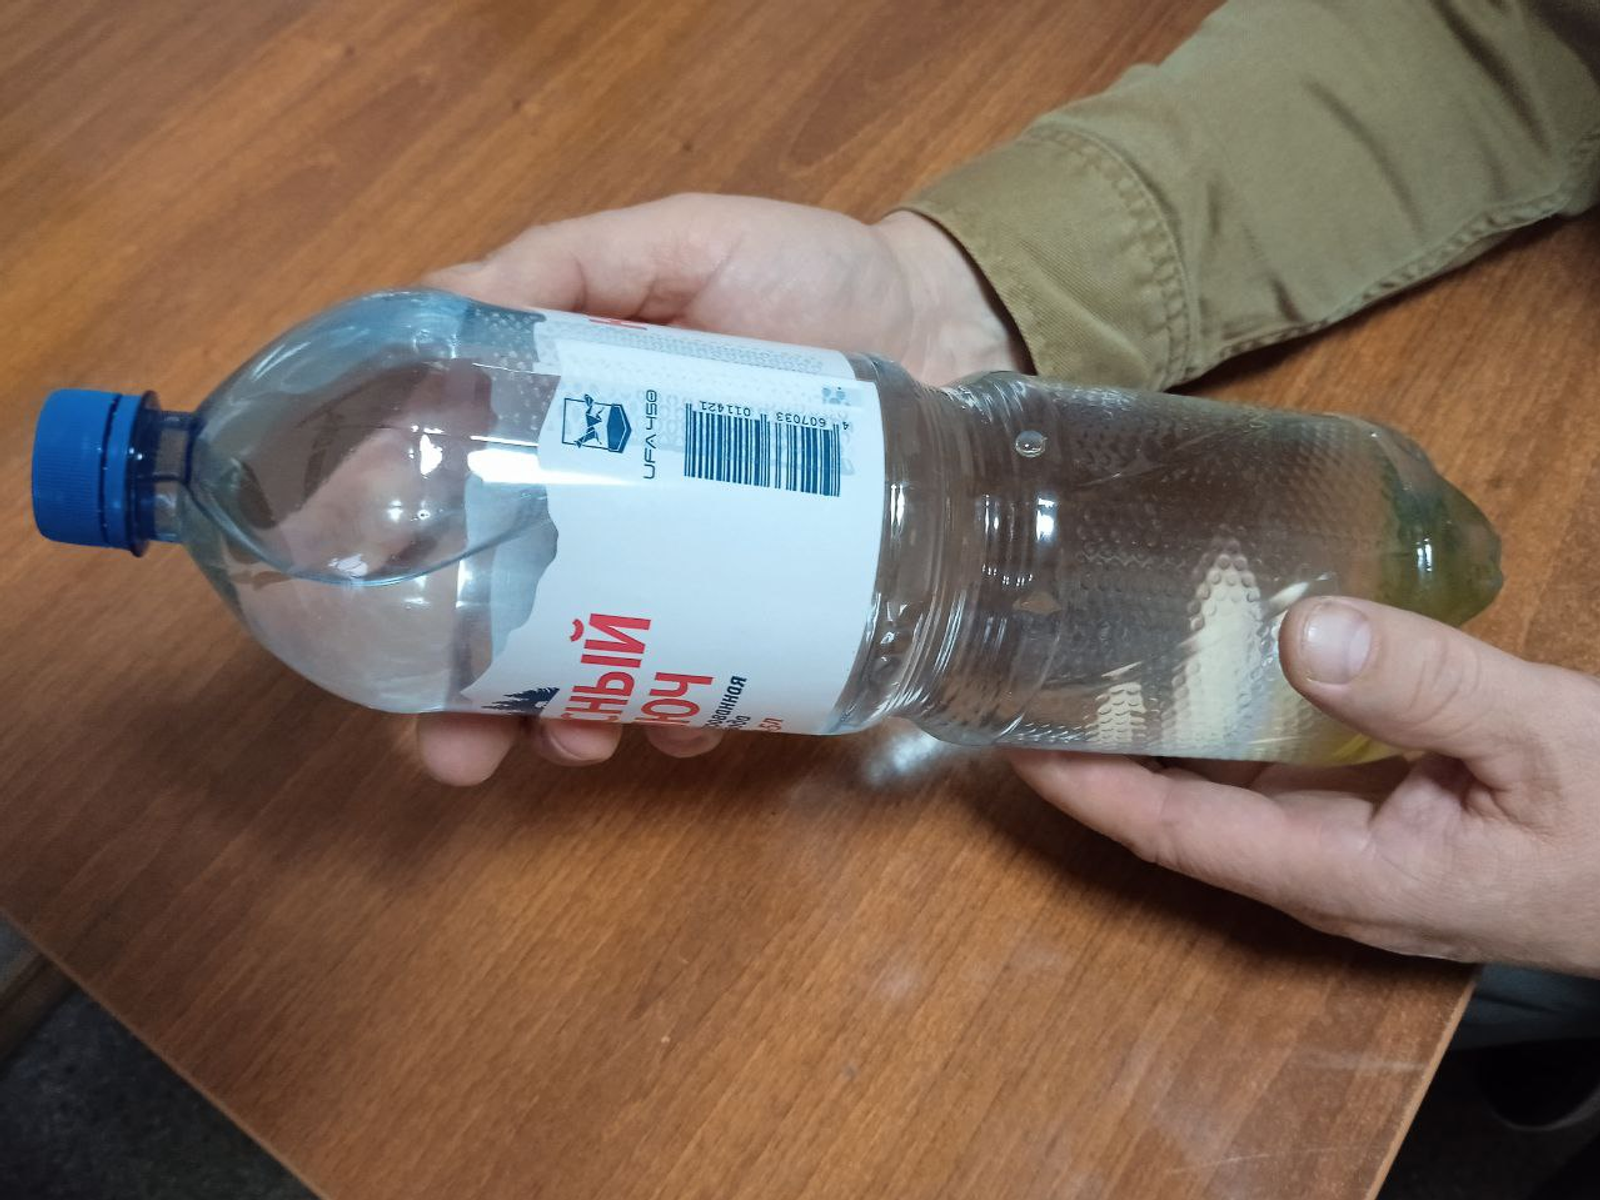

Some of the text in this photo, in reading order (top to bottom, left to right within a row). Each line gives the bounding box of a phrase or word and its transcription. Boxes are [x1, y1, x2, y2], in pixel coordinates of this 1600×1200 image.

[643, 389, 657, 479] UFA 450
[701, 400, 850, 430] 4 607033 011421
[633, 672, 714, 727] ЮЧ
